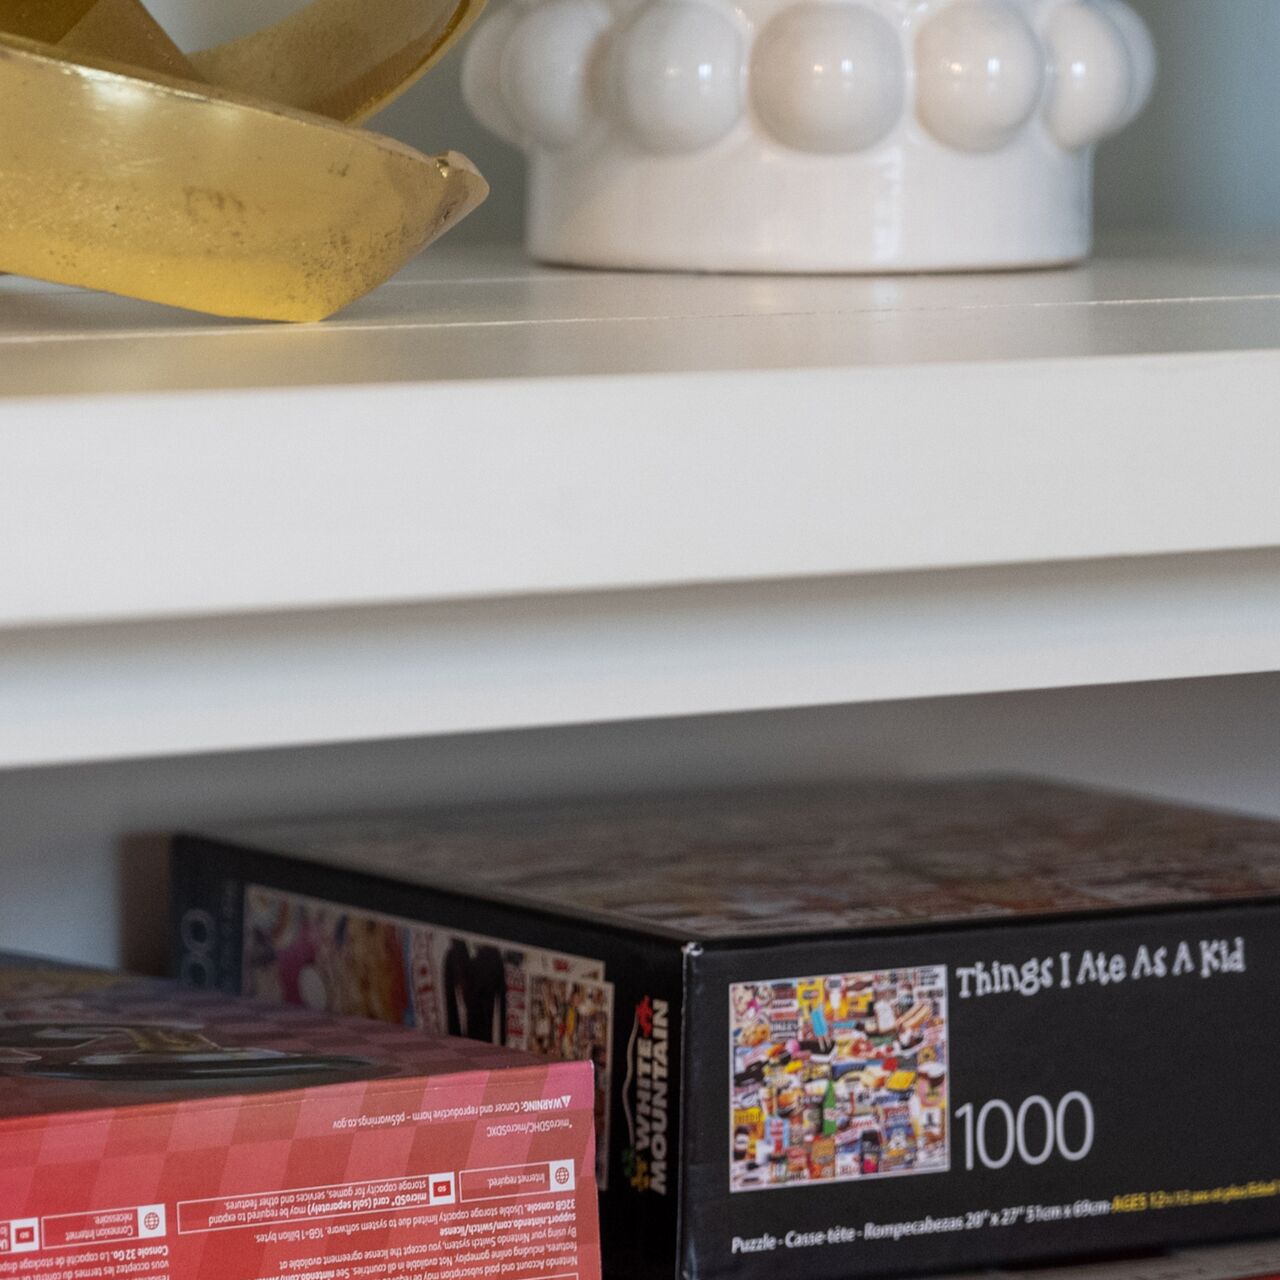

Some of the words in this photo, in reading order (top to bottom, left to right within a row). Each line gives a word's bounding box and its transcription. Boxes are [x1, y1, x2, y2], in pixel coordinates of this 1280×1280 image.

[956, 957, 1053, 997] Things
[1059, 951, 1071, 988] I
[1076, 950, 1126, 984] Ate
[1131, 945, 1166, 979] As
[1171, 941, 1194, 975] A
[1199, 937, 1245, 977] Kid
[635, 1038, 653, 1152] WHITE
[651, 998, 670, 1196] MOUNTAIN
[478, 1103, 493, 1116] and
[494, 1101, 520, 1113] Cancer
[520, 1097, 562, 1111] WARNING:
[411, 1110, 432, 1122] harm
[432, 1104, 478, 1119] reproductive
[332, 1112, 405, 1128] p65warnings.ca.gov
[956, 1091, 1093, 1168] 1000
[487, 1174, 517, 1188] required.
[516, 1172, 545, 1184] Internet
[306, 1199, 351, 1215] separately)
[351, 1196, 372, 1210] (sold
[372, 1195, 390, 1208] card
[523, 1200, 554, 1213] console.
[554, 1198, 575, 1210] 32GB
[439, 1211, 575, 1236] support.nintendo.com/switch/license
[731, 1233, 776, 1253] Puzzle
[863, 1216, 963, 1239] Rompecabezas
